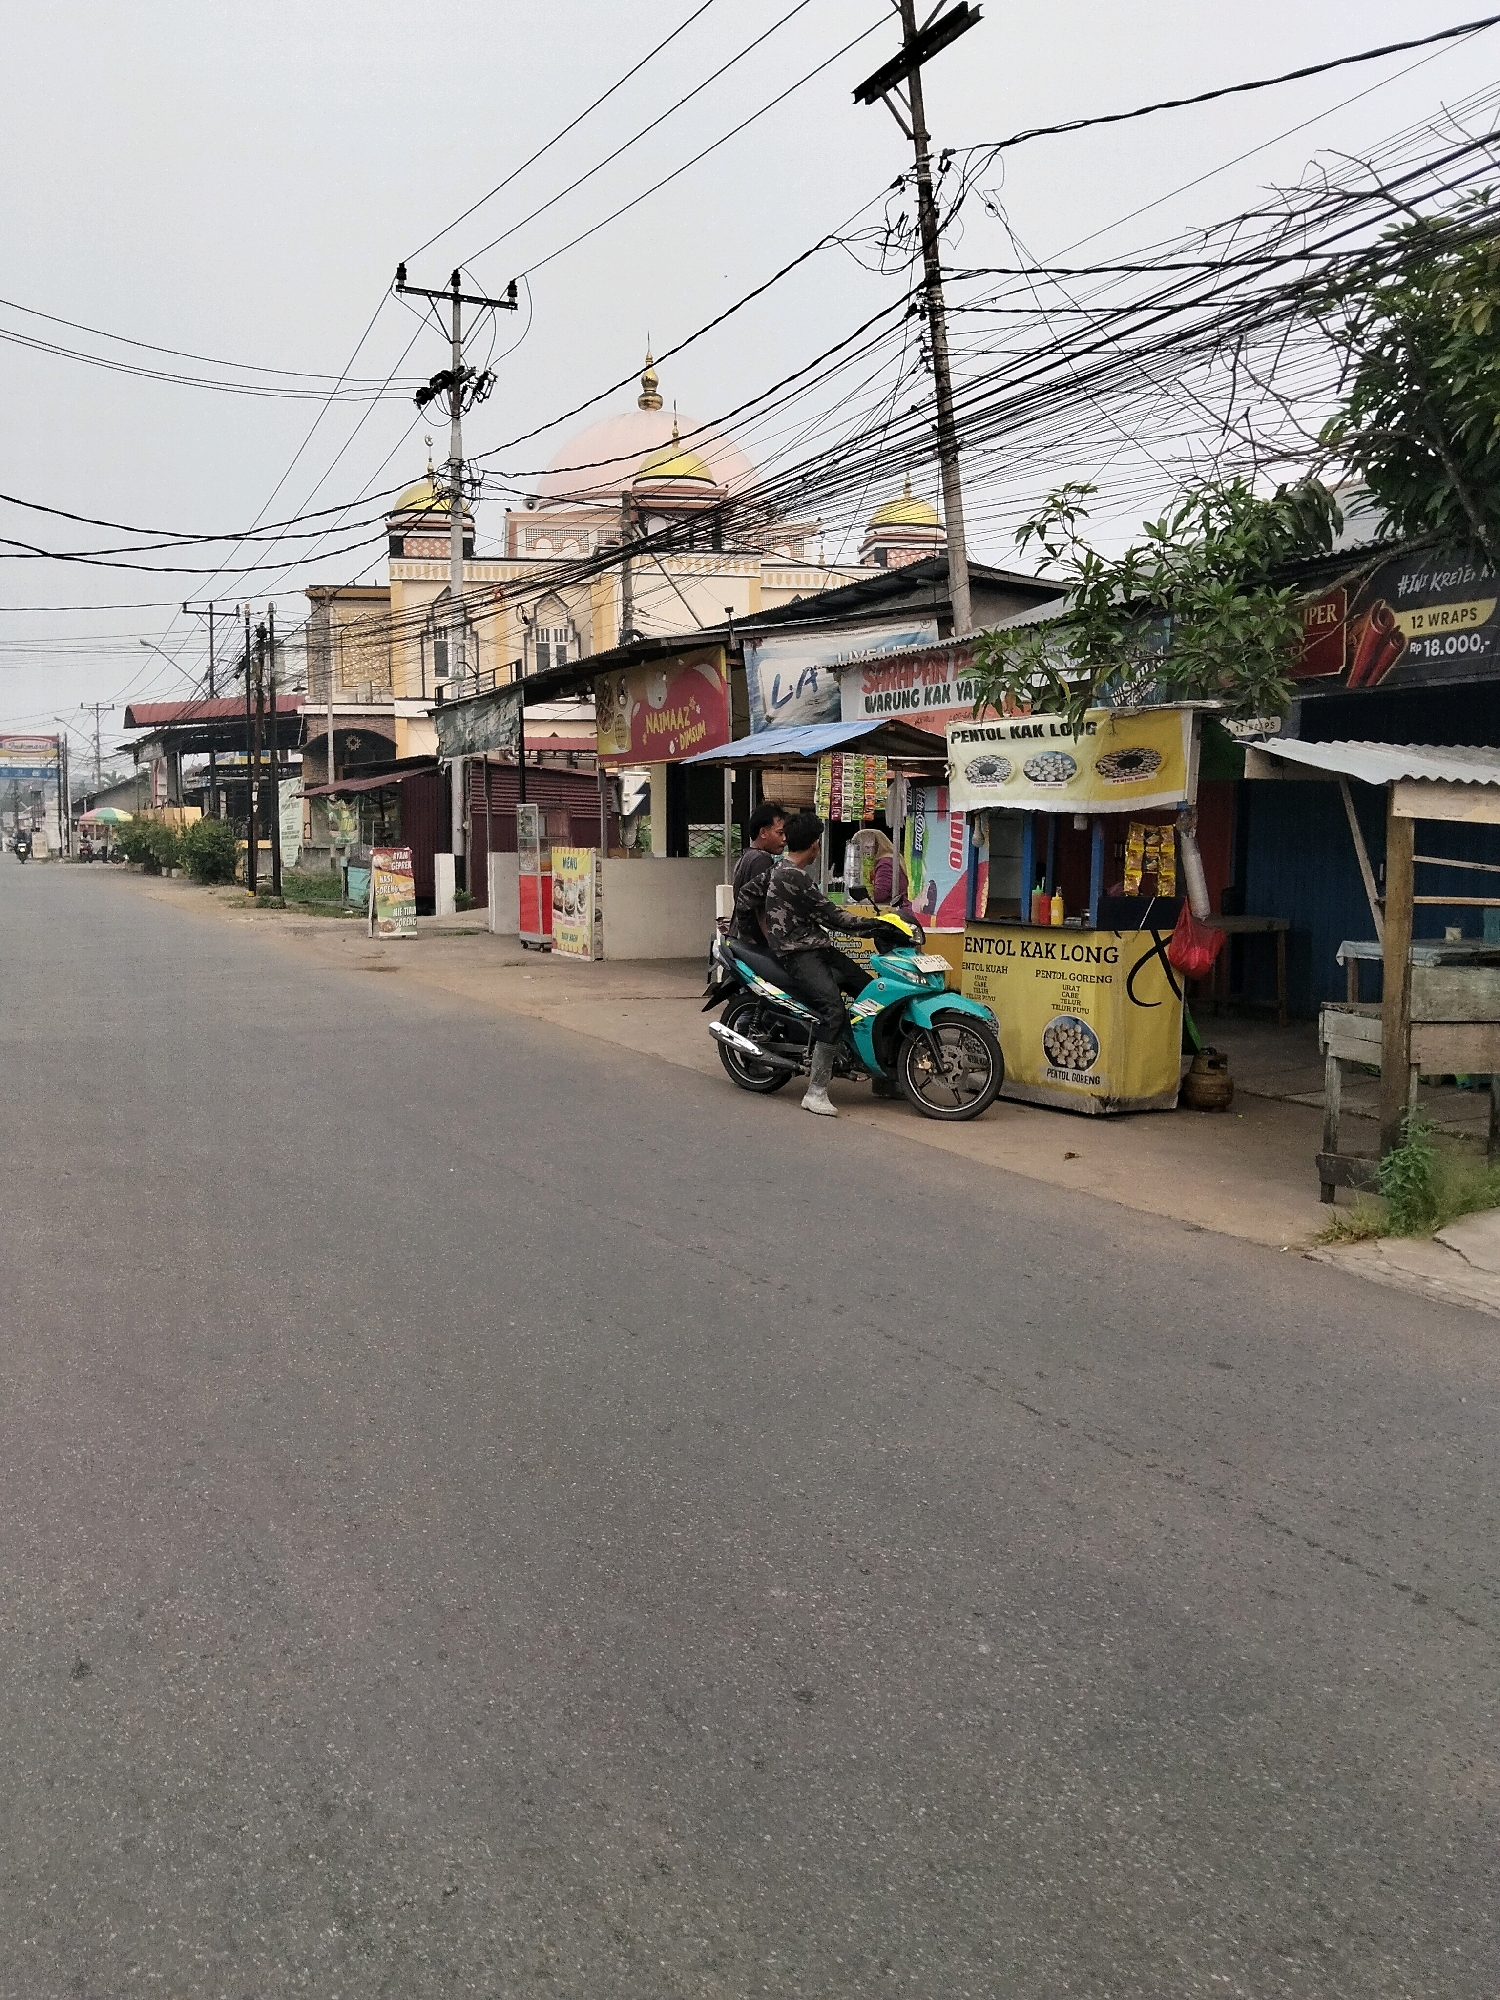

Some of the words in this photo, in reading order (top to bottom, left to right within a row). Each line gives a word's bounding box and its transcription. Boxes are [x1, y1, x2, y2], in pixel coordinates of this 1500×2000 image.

[1412, 615, 1424, 629] 12
[1428, 607, 1478, 627] WRAPS
[1409, 642, 1422, 655] Rp
[1424, 633, 1491, 658] 18.000,-
[864, 688, 920, 714] WARUNG
[924, 683, 951, 706] KAK
[950, 727, 1006, 745] PENTOL
[1010, 724, 1045, 740] KAK
[562, 856, 578, 870] MENU
[964, 936, 1016, 956] ENTOL
[1020, 940, 1056, 960] KAK
[1060, 944, 1119, 964] LONG
[962, 962, 984, 972] ENTOL
[986, 964, 1008, 974] KUAH
[1034, 969, 1068, 981] PENTOL
[1069, 972, 1113, 984] GORENG
[1062, 984, 1080, 992] URAT
[1051, 1004, 1072, 1012] TELUR
[1060, 998, 1082, 1006] TELUR
